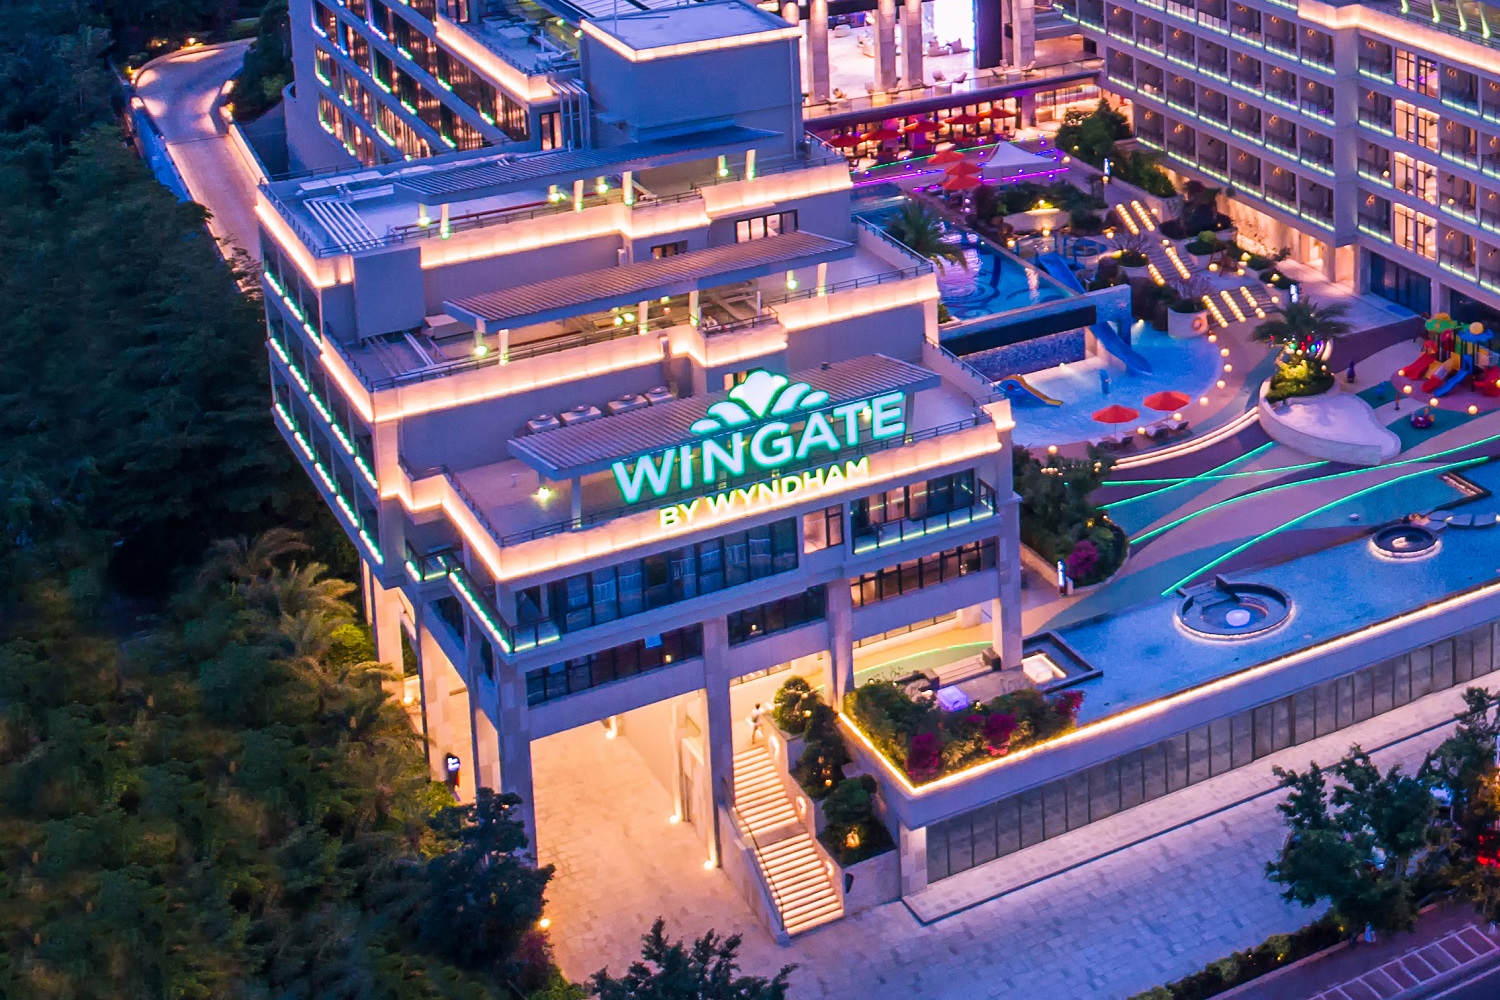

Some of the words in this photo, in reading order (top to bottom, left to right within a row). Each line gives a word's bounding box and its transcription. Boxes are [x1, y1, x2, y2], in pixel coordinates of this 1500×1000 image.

[612, 392, 906, 503] WINGATE
[659, 498, 700, 528] BY
[706, 457, 869, 514] WYNDHAM
